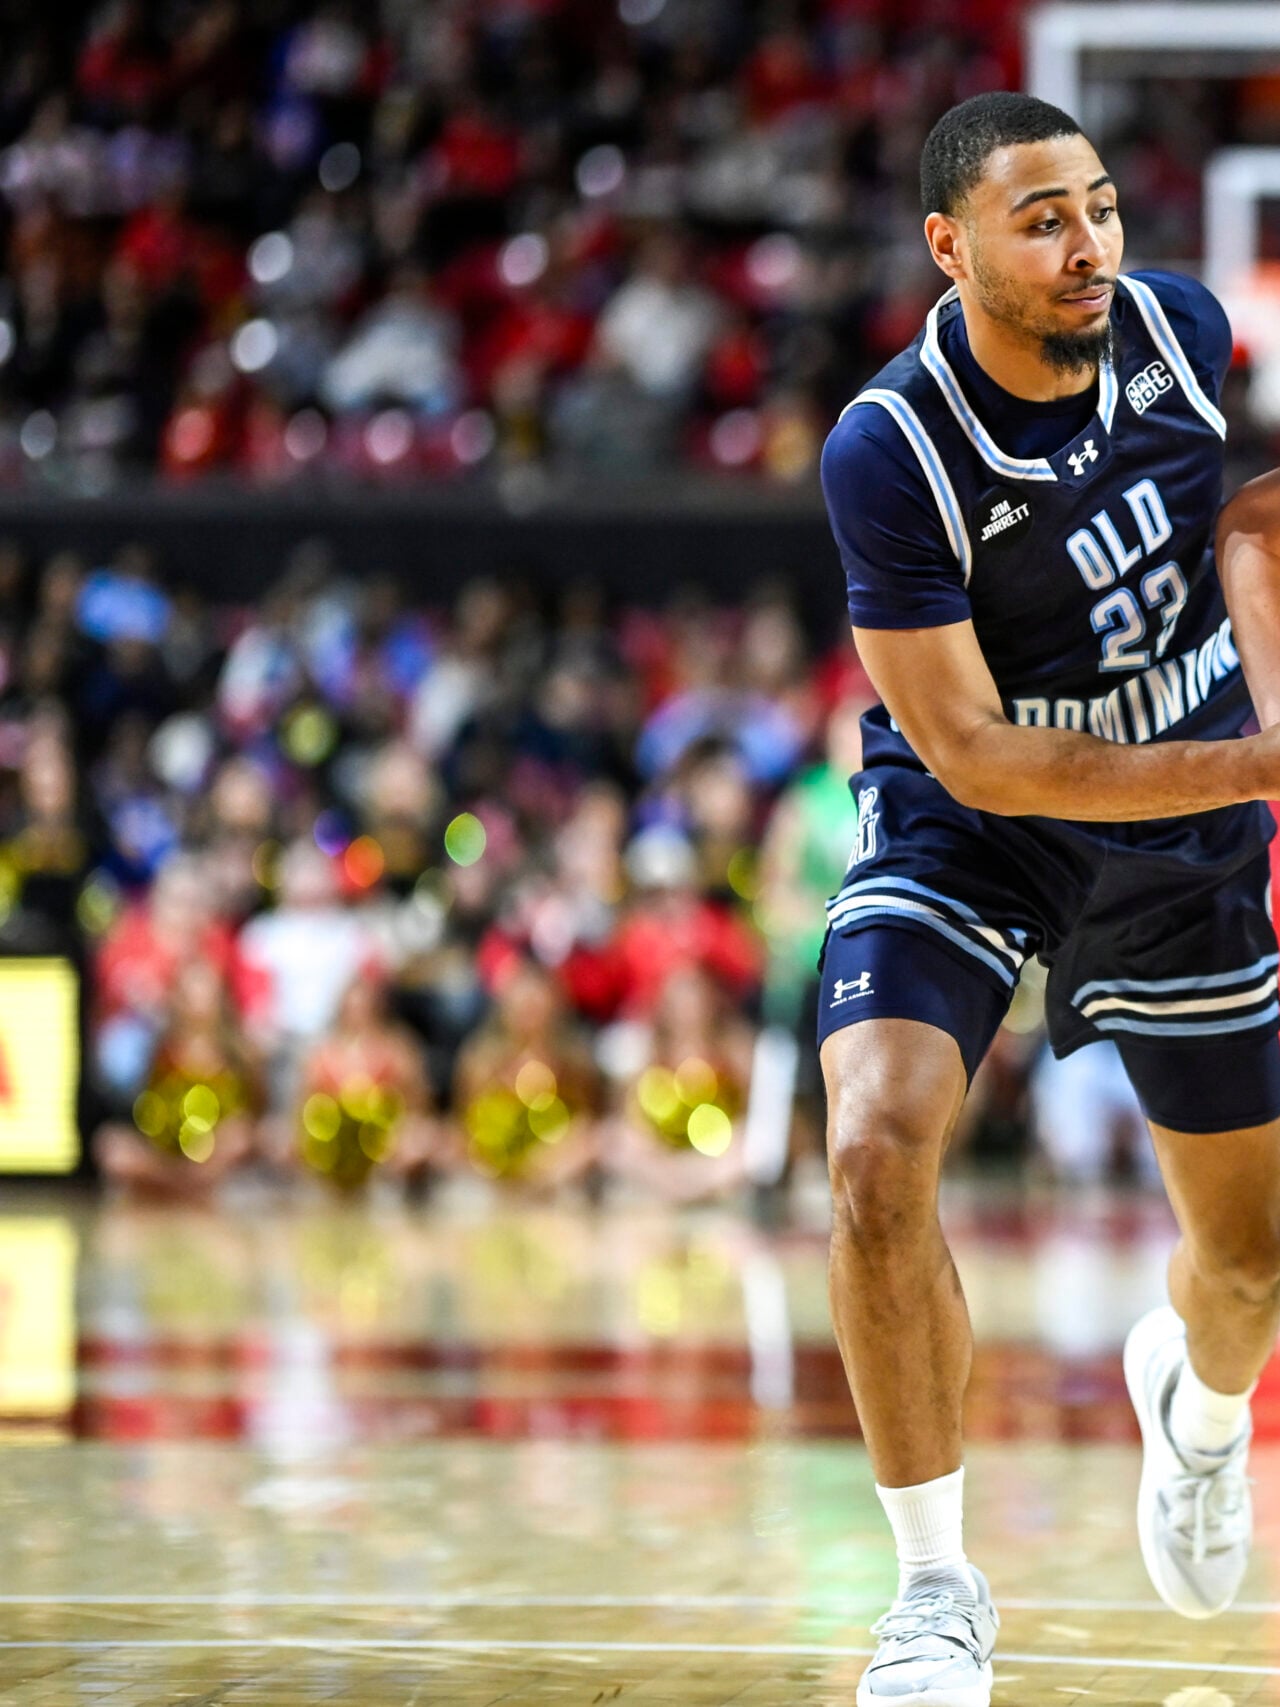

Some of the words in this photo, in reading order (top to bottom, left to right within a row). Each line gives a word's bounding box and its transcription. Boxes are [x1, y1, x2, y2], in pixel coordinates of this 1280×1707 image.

[981, 503, 1030, 542] JARRETT
[990, 500, 1011, 522] JIM
[1065, 478, 1173, 591] OLD
